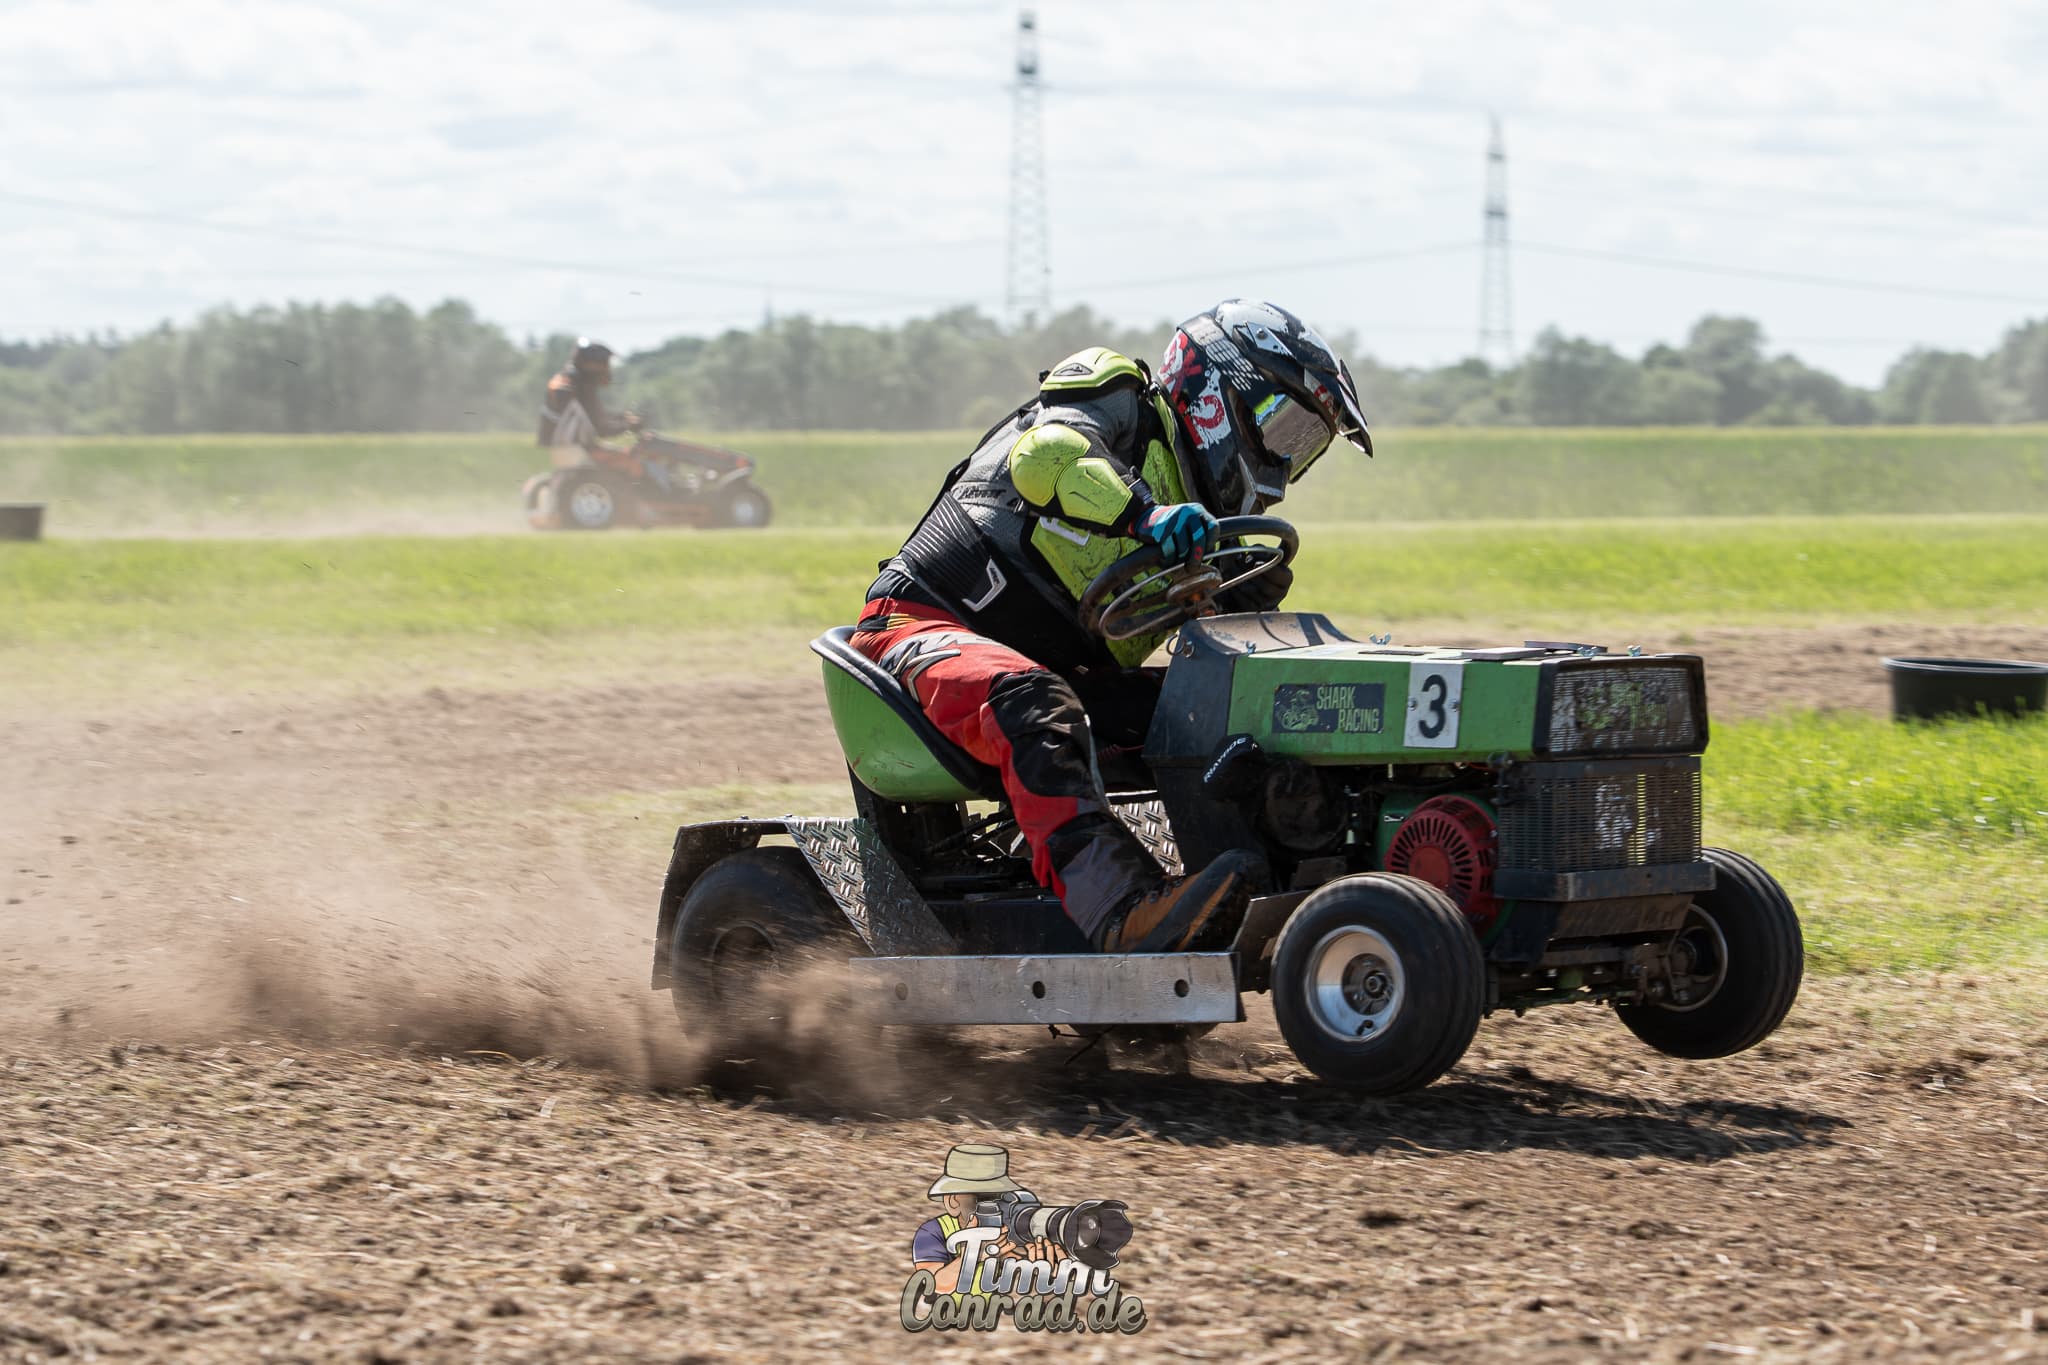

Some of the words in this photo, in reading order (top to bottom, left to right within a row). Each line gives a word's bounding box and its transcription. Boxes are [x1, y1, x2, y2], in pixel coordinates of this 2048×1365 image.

[1316, 685, 1356, 710] SHARK
[1418, 674, 1447, 739] 3
[1338, 708, 1380, 732] RACING
